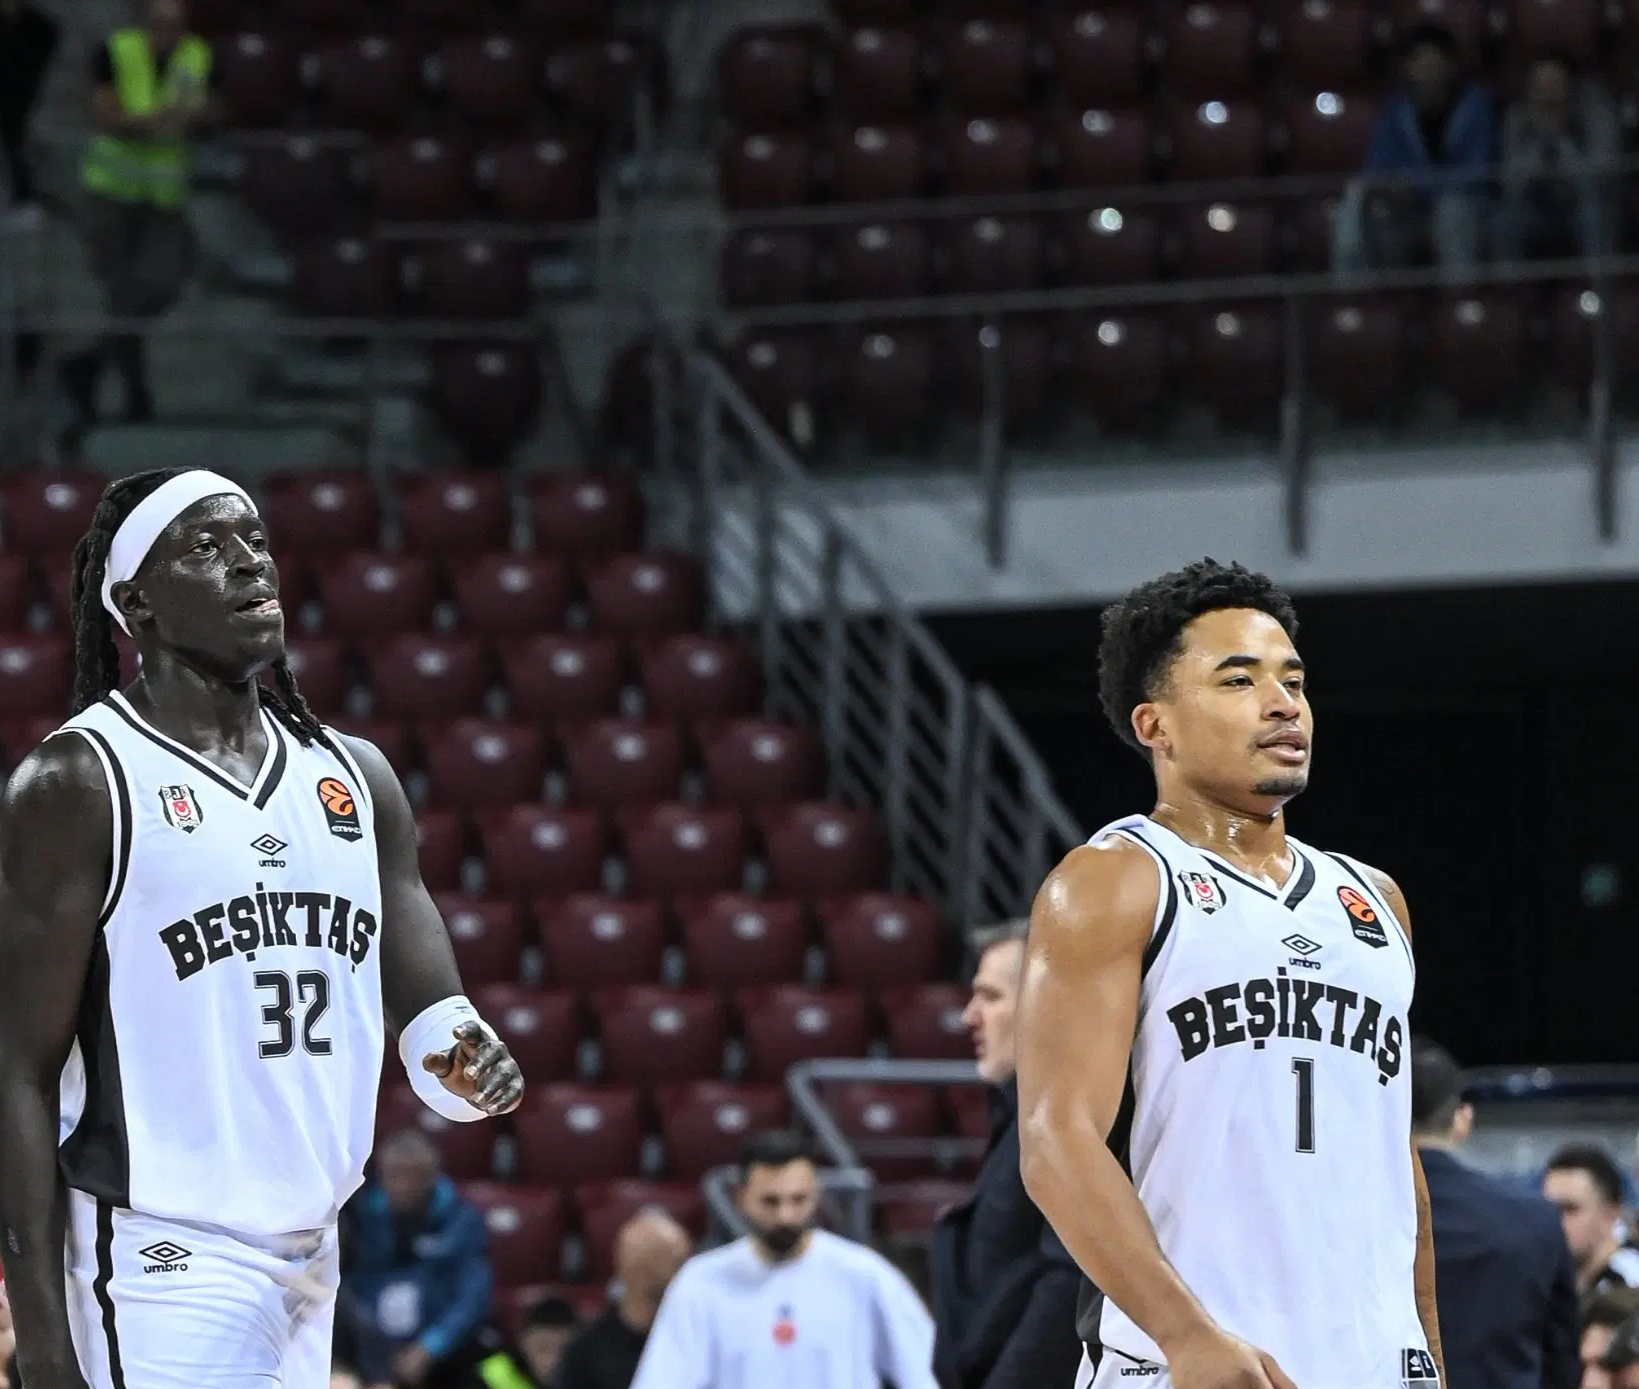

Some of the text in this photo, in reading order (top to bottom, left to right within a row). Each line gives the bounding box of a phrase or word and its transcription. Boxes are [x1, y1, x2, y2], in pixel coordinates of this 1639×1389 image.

[159, 882, 377, 981] BEŞİKTAŞ
[1289, 956, 1322, 970] umbro
[253, 969, 333, 1060] 32
[1167, 967, 1402, 1086] BEŞİKTAŞ
[1291, 1057, 1316, 1154] 1
[143, 1259, 188, 1272] umbro
[1120, 1365, 1159, 1376] umbro
